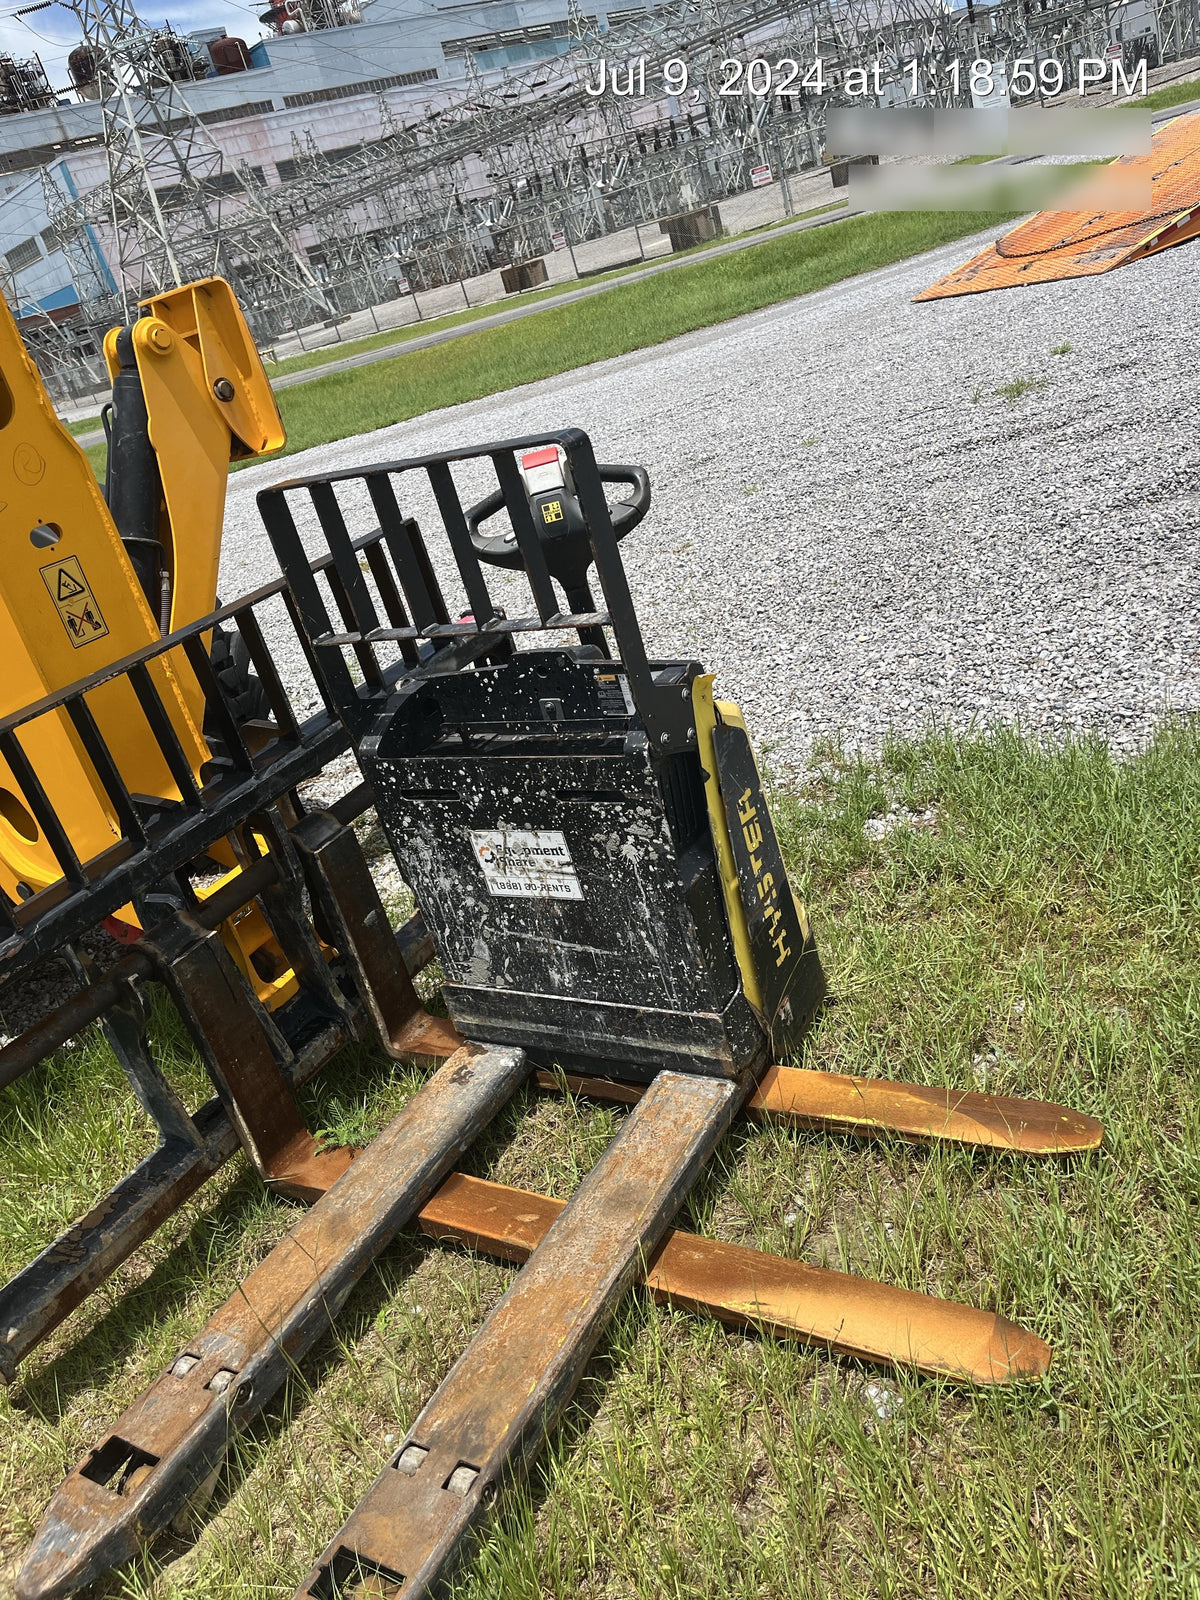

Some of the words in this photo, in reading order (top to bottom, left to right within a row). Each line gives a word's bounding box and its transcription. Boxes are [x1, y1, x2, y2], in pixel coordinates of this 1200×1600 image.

[495, 844, 566, 858] Equpment
[736, 787, 792, 968] HYSTER
[496, 881, 522, 891] (888)
